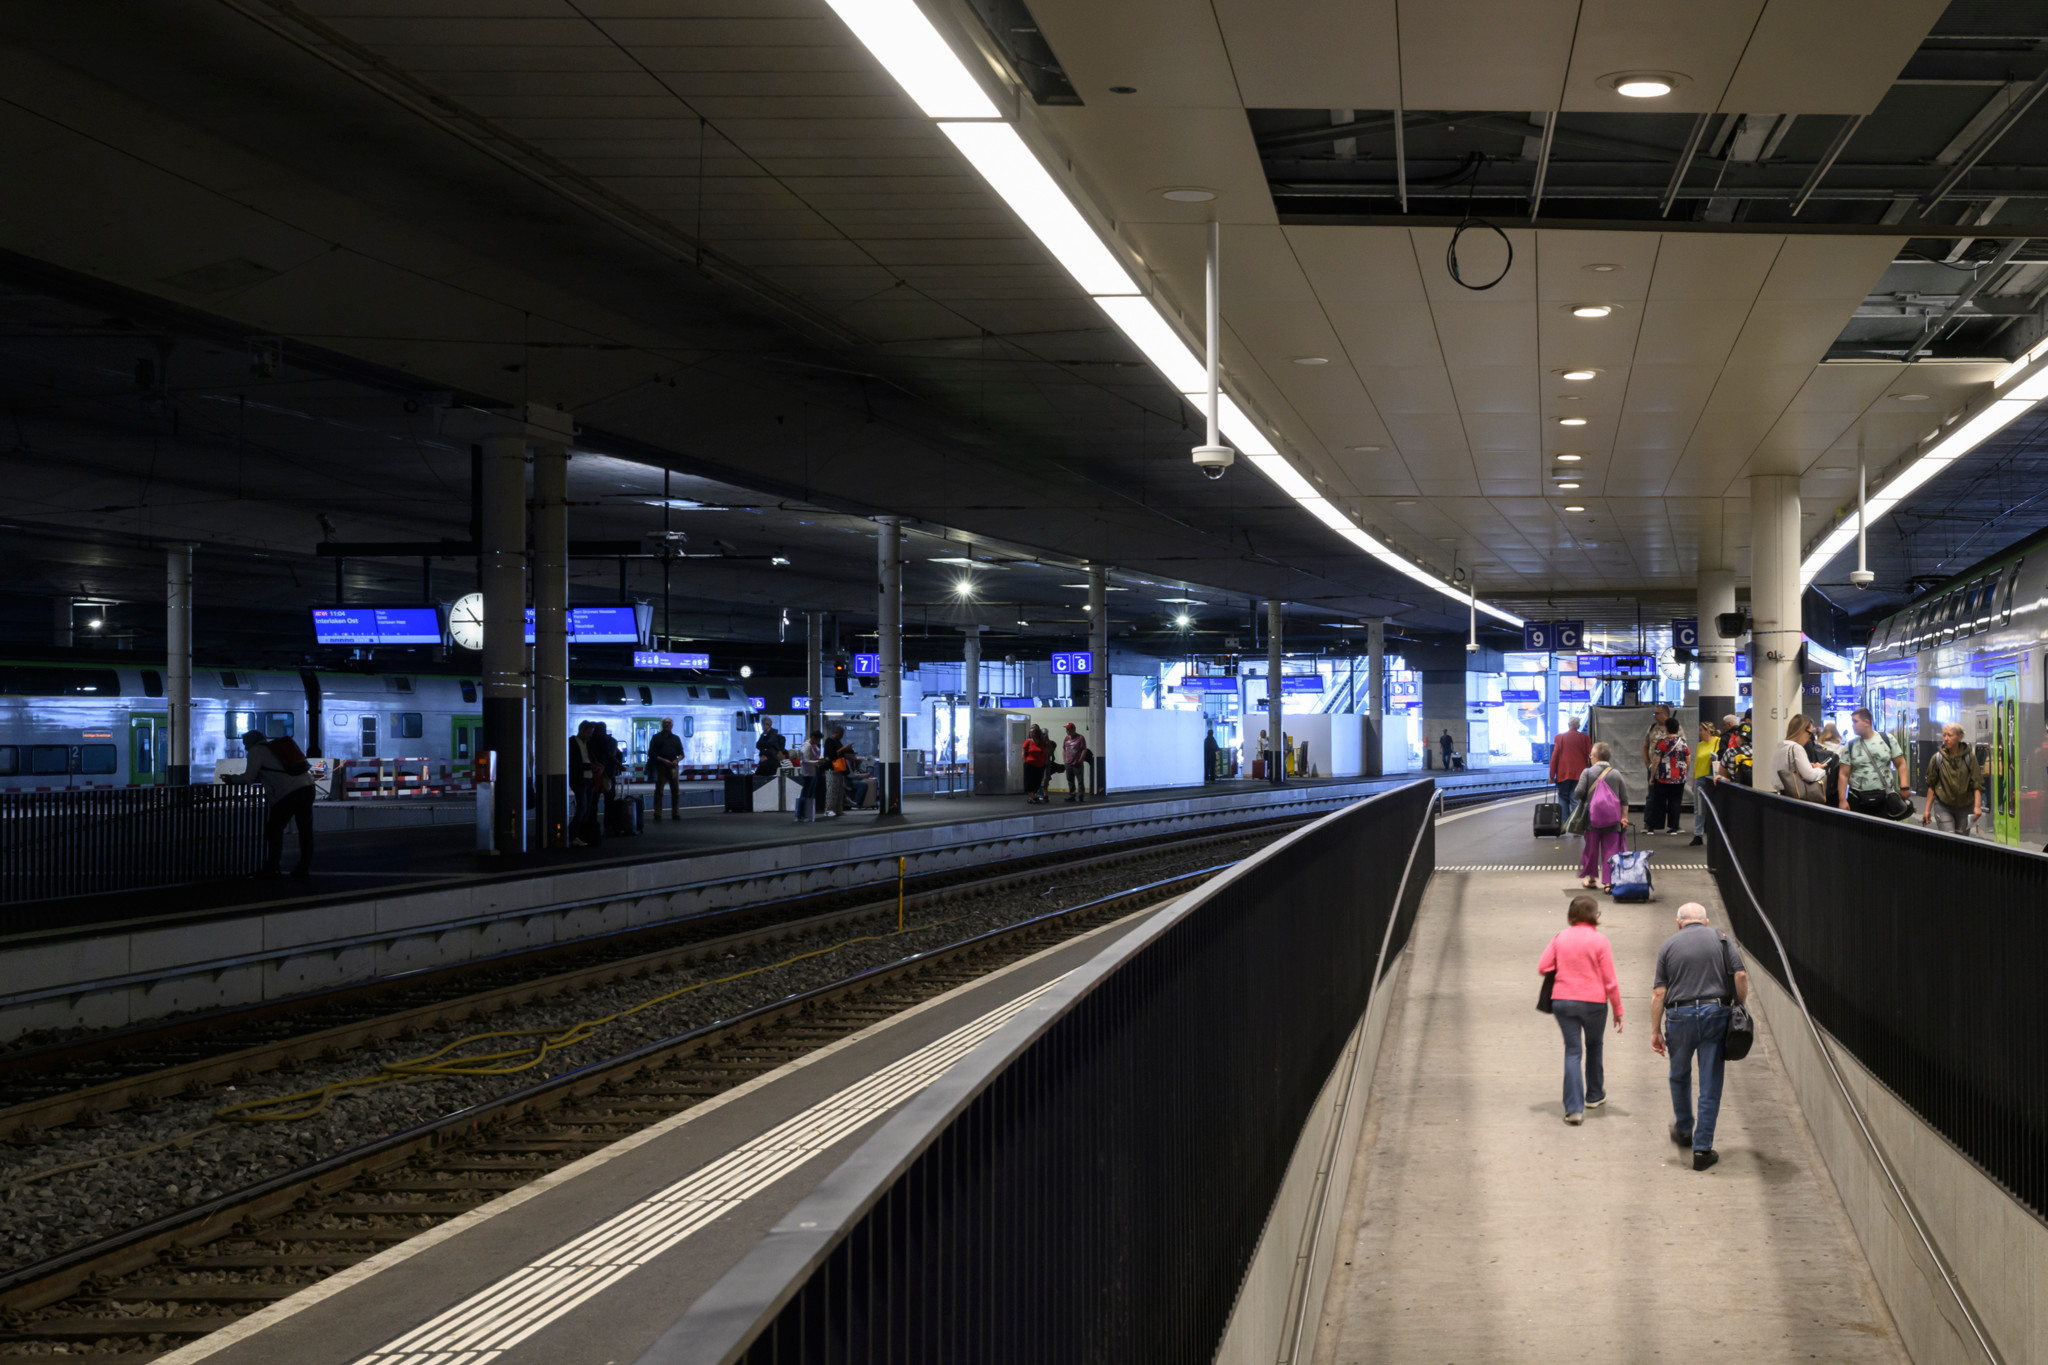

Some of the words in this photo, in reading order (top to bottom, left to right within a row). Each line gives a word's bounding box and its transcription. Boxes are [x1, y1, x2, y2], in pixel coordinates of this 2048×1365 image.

[1533, 631, 1544, 647] 9
[1562, 630, 1576, 646] C
[1680, 628, 1695, 645] C
[861, 660, 868, 671] 7
[1057, 659, 1066, 671] C
[1078, 658, 1086, 671] 8
[1742, 687, 1749, 695] 9
[1811, 686, 1821, 694] 10
[72, 746, 79, 758] 2
